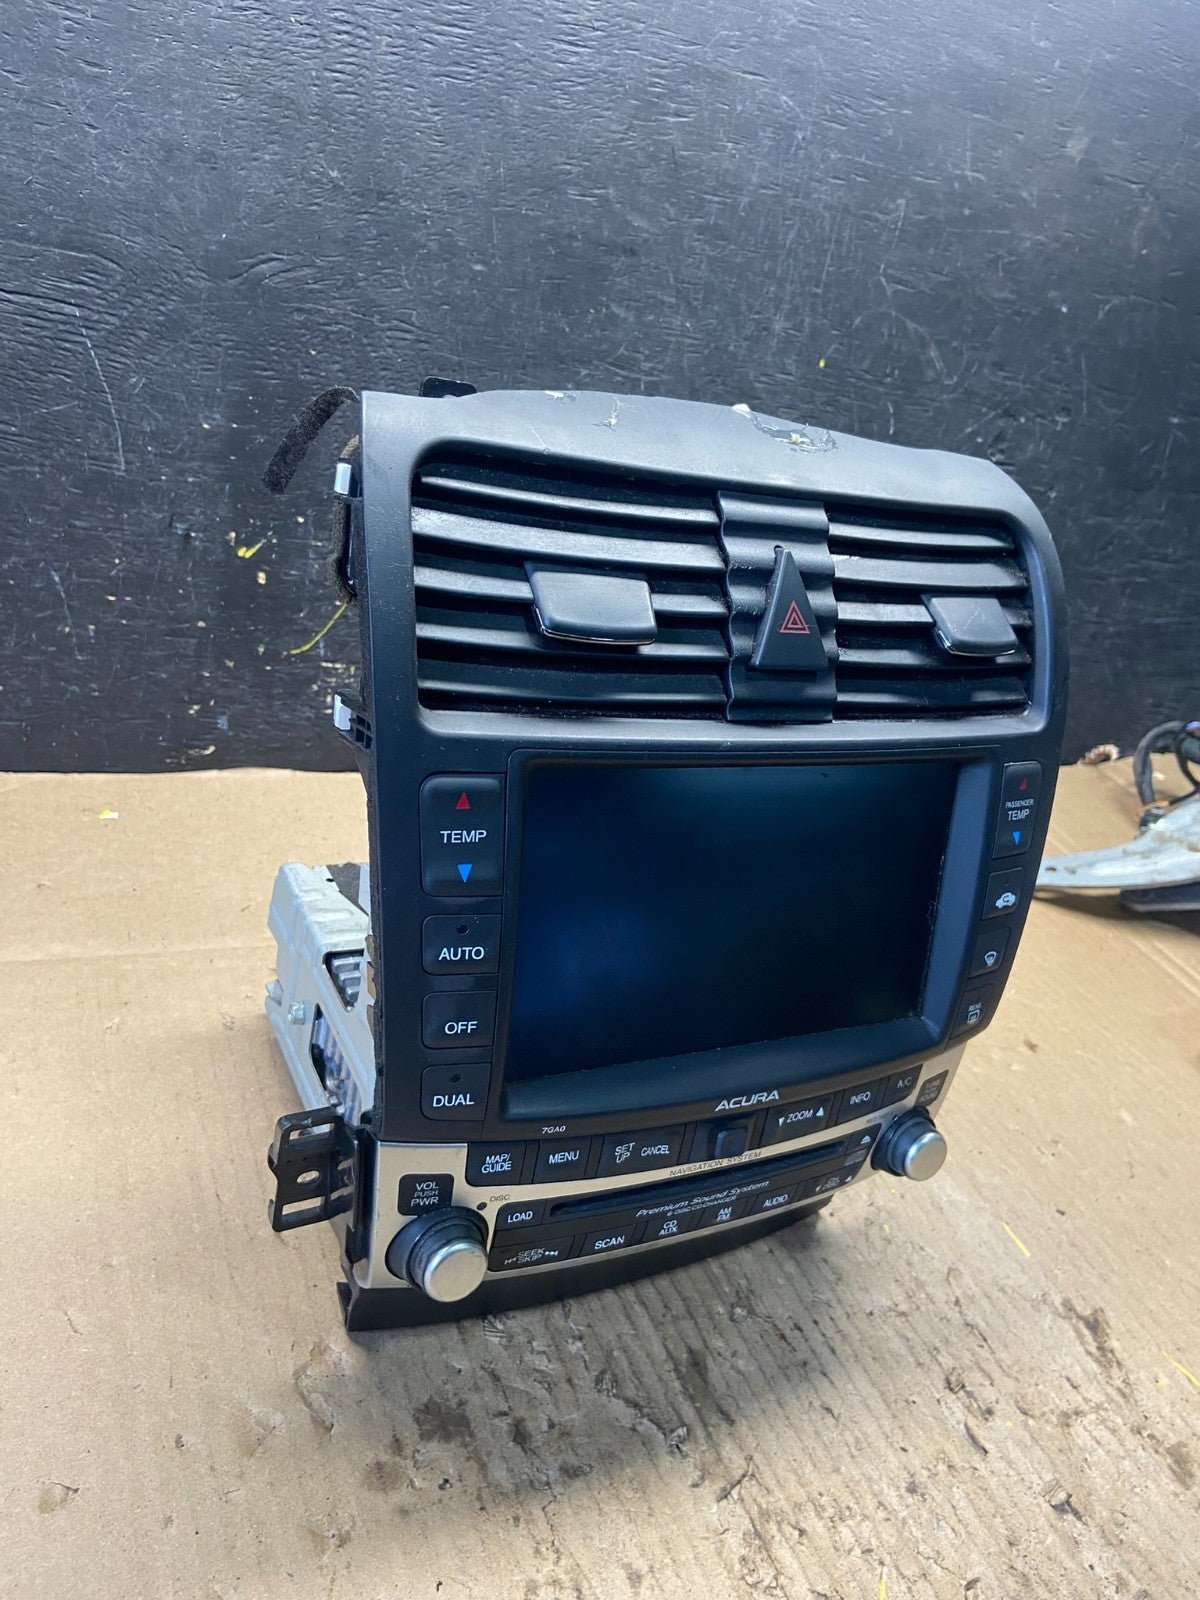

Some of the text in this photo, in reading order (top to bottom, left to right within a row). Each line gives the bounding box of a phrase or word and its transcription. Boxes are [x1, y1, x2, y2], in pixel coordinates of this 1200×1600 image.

[1007, 809, 1030, 821] TEMP
[440, 829, 487, 844] TEMP
[438, 946, 485, 960] AUTO
[444, 1021, 478, 1035] OFF
[896, 1076, 912, 1089] A/C
[432, 1093, 475, 1108] DUAL
[714, 1090, 780, 1112] ACURA
[849, 1091, 871, 1105] INFO
[786, 1109, 813, 1123] ZOOM
[614, 1142, 635, 1155] SET
[641, 1144, 671, 1156] CANCEL
[485, 1153, 511, 1164] MAP/
[548, 1150, 579, 1165] MENU
[615, 1152, 631, 1163] UP
[668, 1151, 763, 1176] NAVIGATION SYSTEM
[481, 1161, 512, 1173] GUIDE
[416, 1181, 439, 1190] VOL
[414, 1189, 439, 1198] PUSH
[489, 1194, 511, 1202] DISC
[635, 1181, 769, 1218] Premium Sound System
[410, 1196, 439, 1207] PWR
[762, 1194, 789, 1208] AUDIO
[507, 1210, 533, 1223] LOAD
[717, 1206, 732, 1215] AM
[663, 1219, 677, 1228] CD
[658, 1226, 678, 1236] AUX
[594, 1235, 625, 1250] SCAN
[517, 1247, 546, 1257] SEEK
[517, 1254, 542, 1264] SKIP
